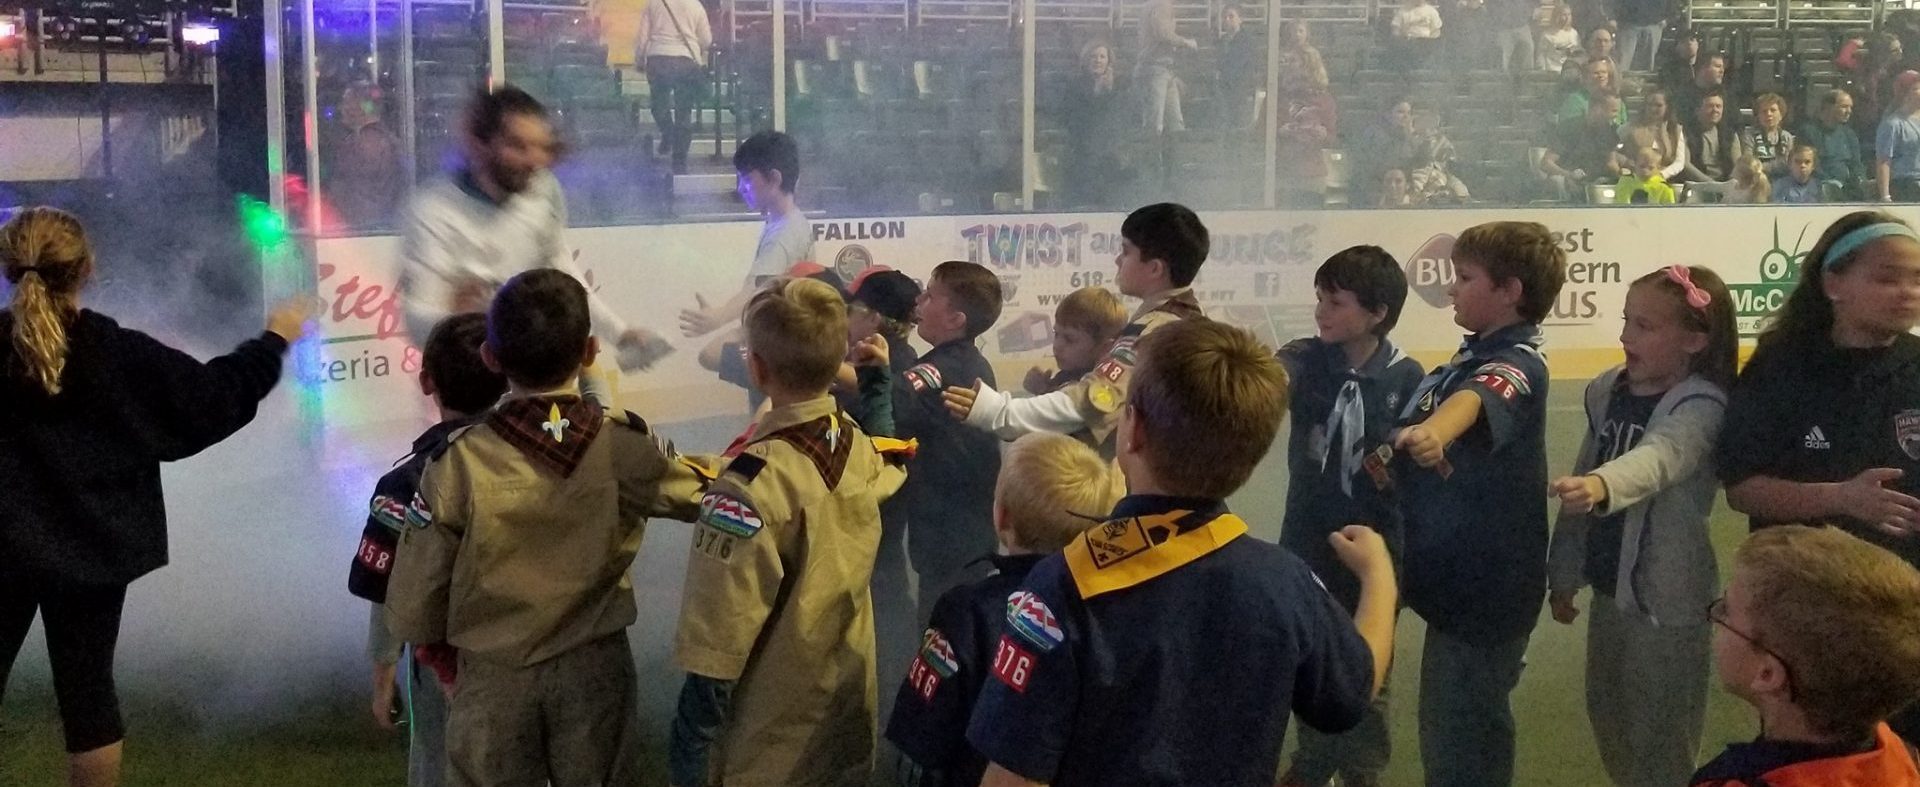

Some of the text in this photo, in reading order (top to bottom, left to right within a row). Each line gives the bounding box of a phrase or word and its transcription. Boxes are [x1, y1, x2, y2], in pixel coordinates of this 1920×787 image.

[961, 222, 1317, 270] TWIST an UNCE
[1549, 228, 1594, 252] est
[1563, 261, 1621, 284] ern
[1548, 290, 1598, 319] us
[1729, 289, 1784, 312] McC
[401, 345, 422, 374] &
